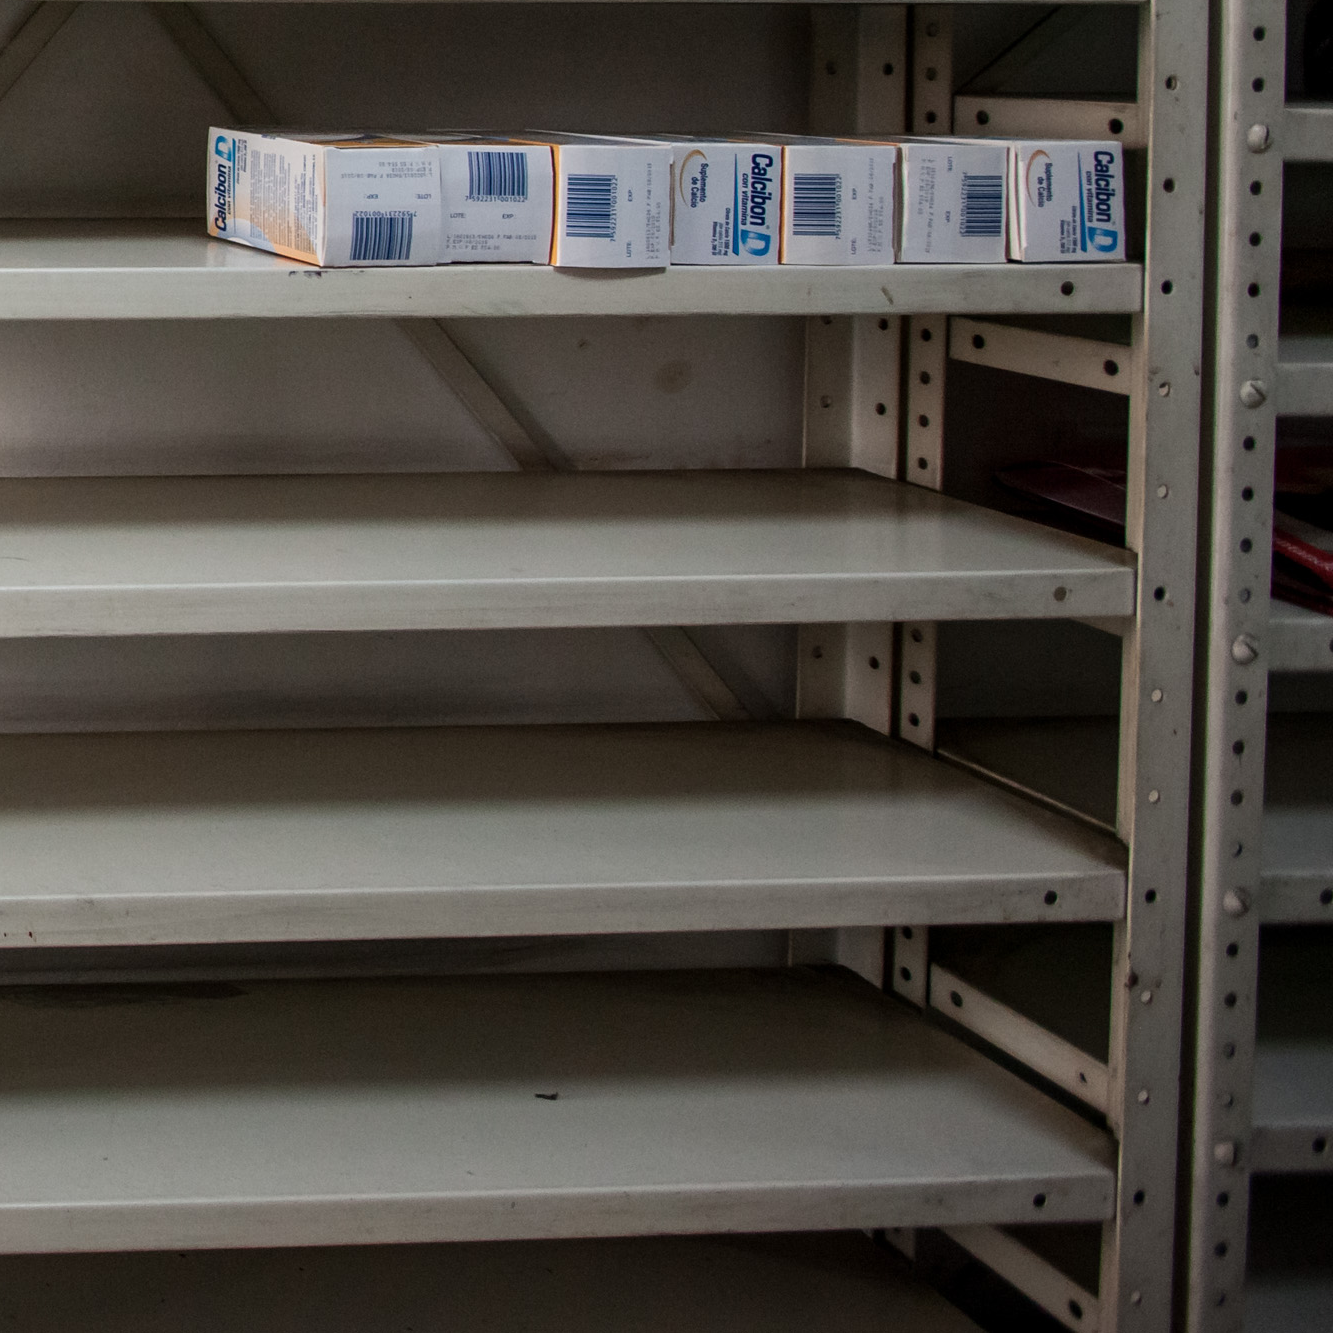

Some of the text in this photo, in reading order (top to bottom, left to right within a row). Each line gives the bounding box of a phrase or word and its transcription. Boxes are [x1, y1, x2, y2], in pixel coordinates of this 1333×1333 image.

[215, 136, 231, 231] Calcibon D
[691, 176, 698, 185] de
[699, 163, 709, 202] Suplemento
[1038, 176, 1044, 185] de
[1045, 162, 1053, 202] Suplemento
[740, 153, 774, 256] Calcibon D
[1087, 150, 1118, 252] Calcibon D
